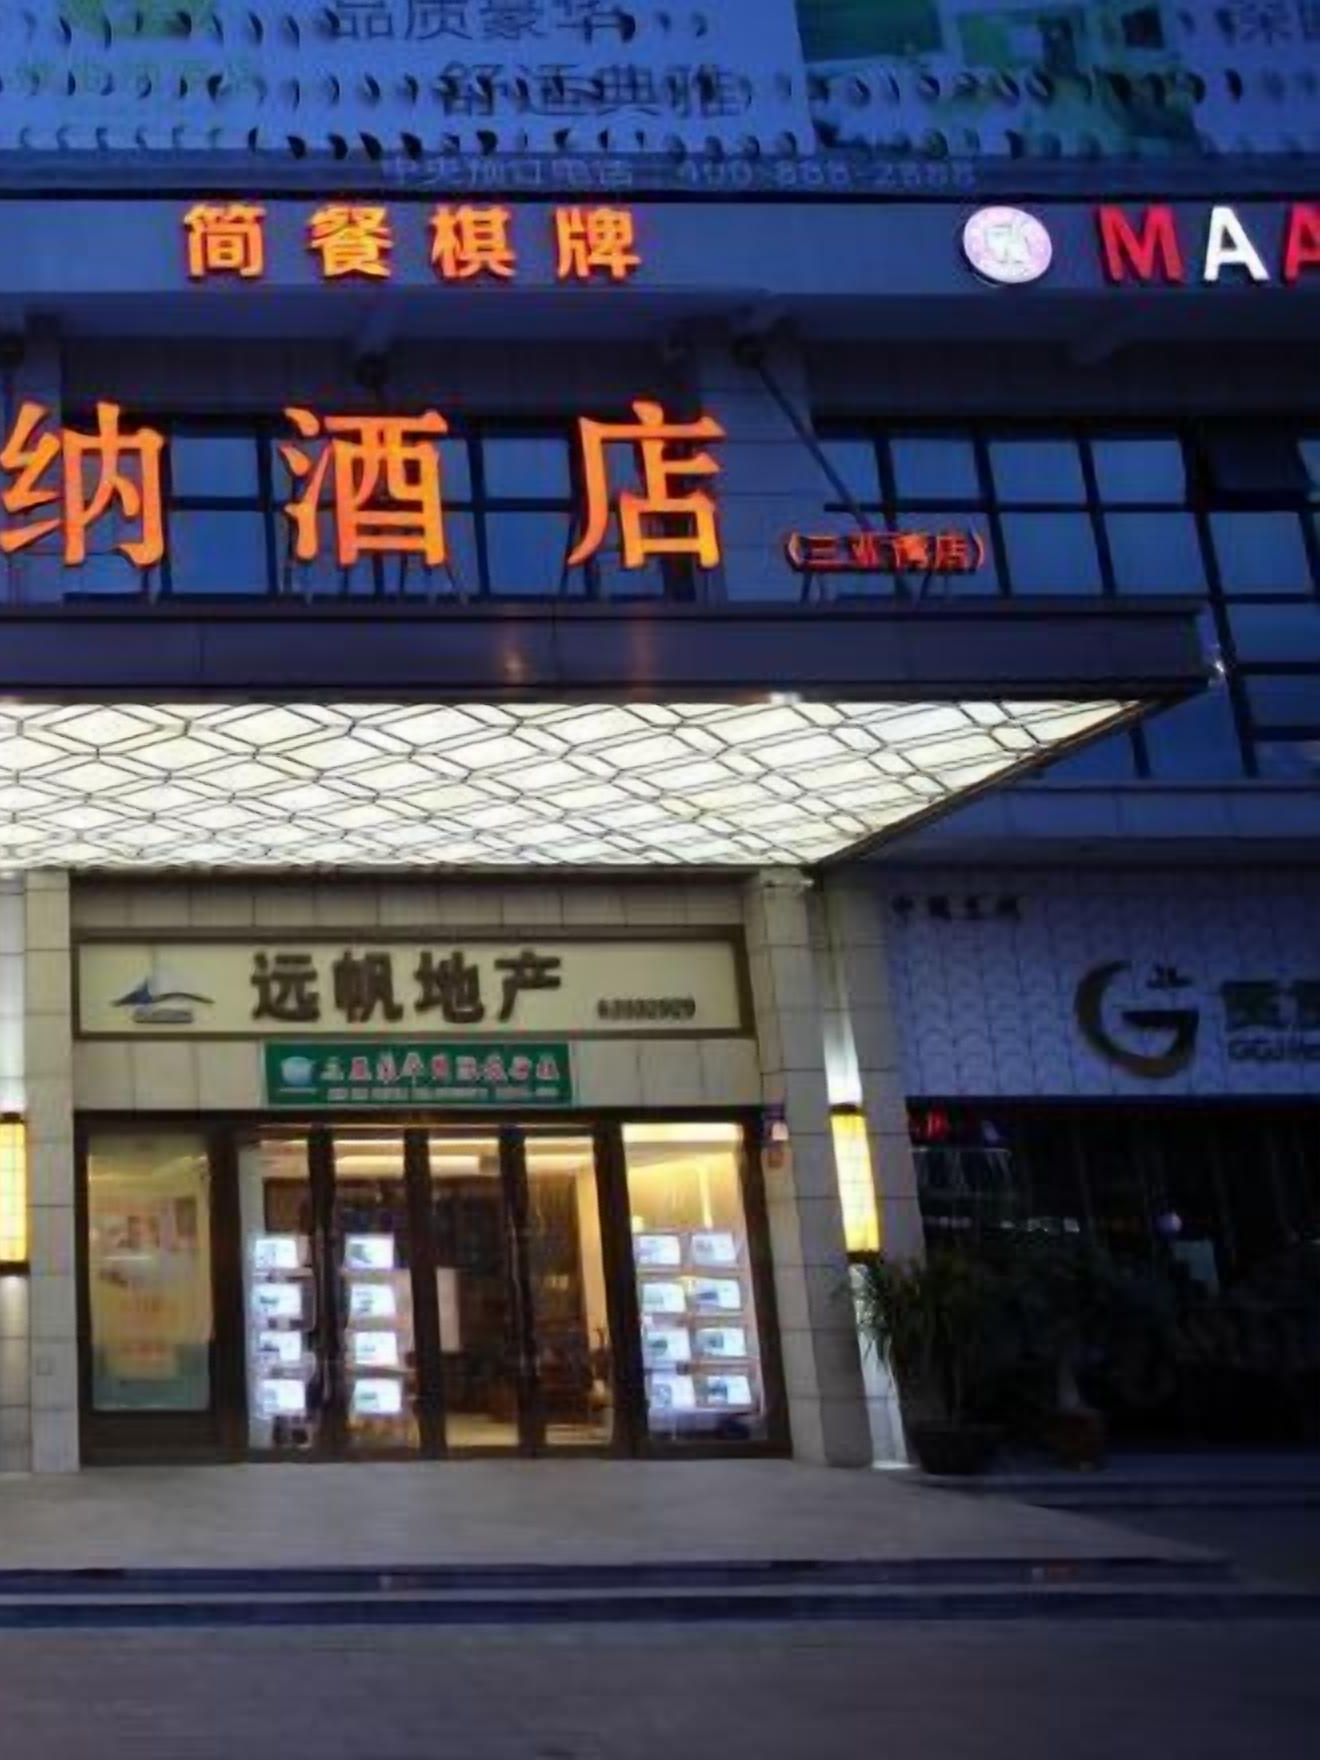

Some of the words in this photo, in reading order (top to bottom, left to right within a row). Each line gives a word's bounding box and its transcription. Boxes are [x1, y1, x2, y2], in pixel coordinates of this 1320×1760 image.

[184, 203, 640, 280] 简餐棋牌
[250, 950, 562, 1024] 远帆地产
